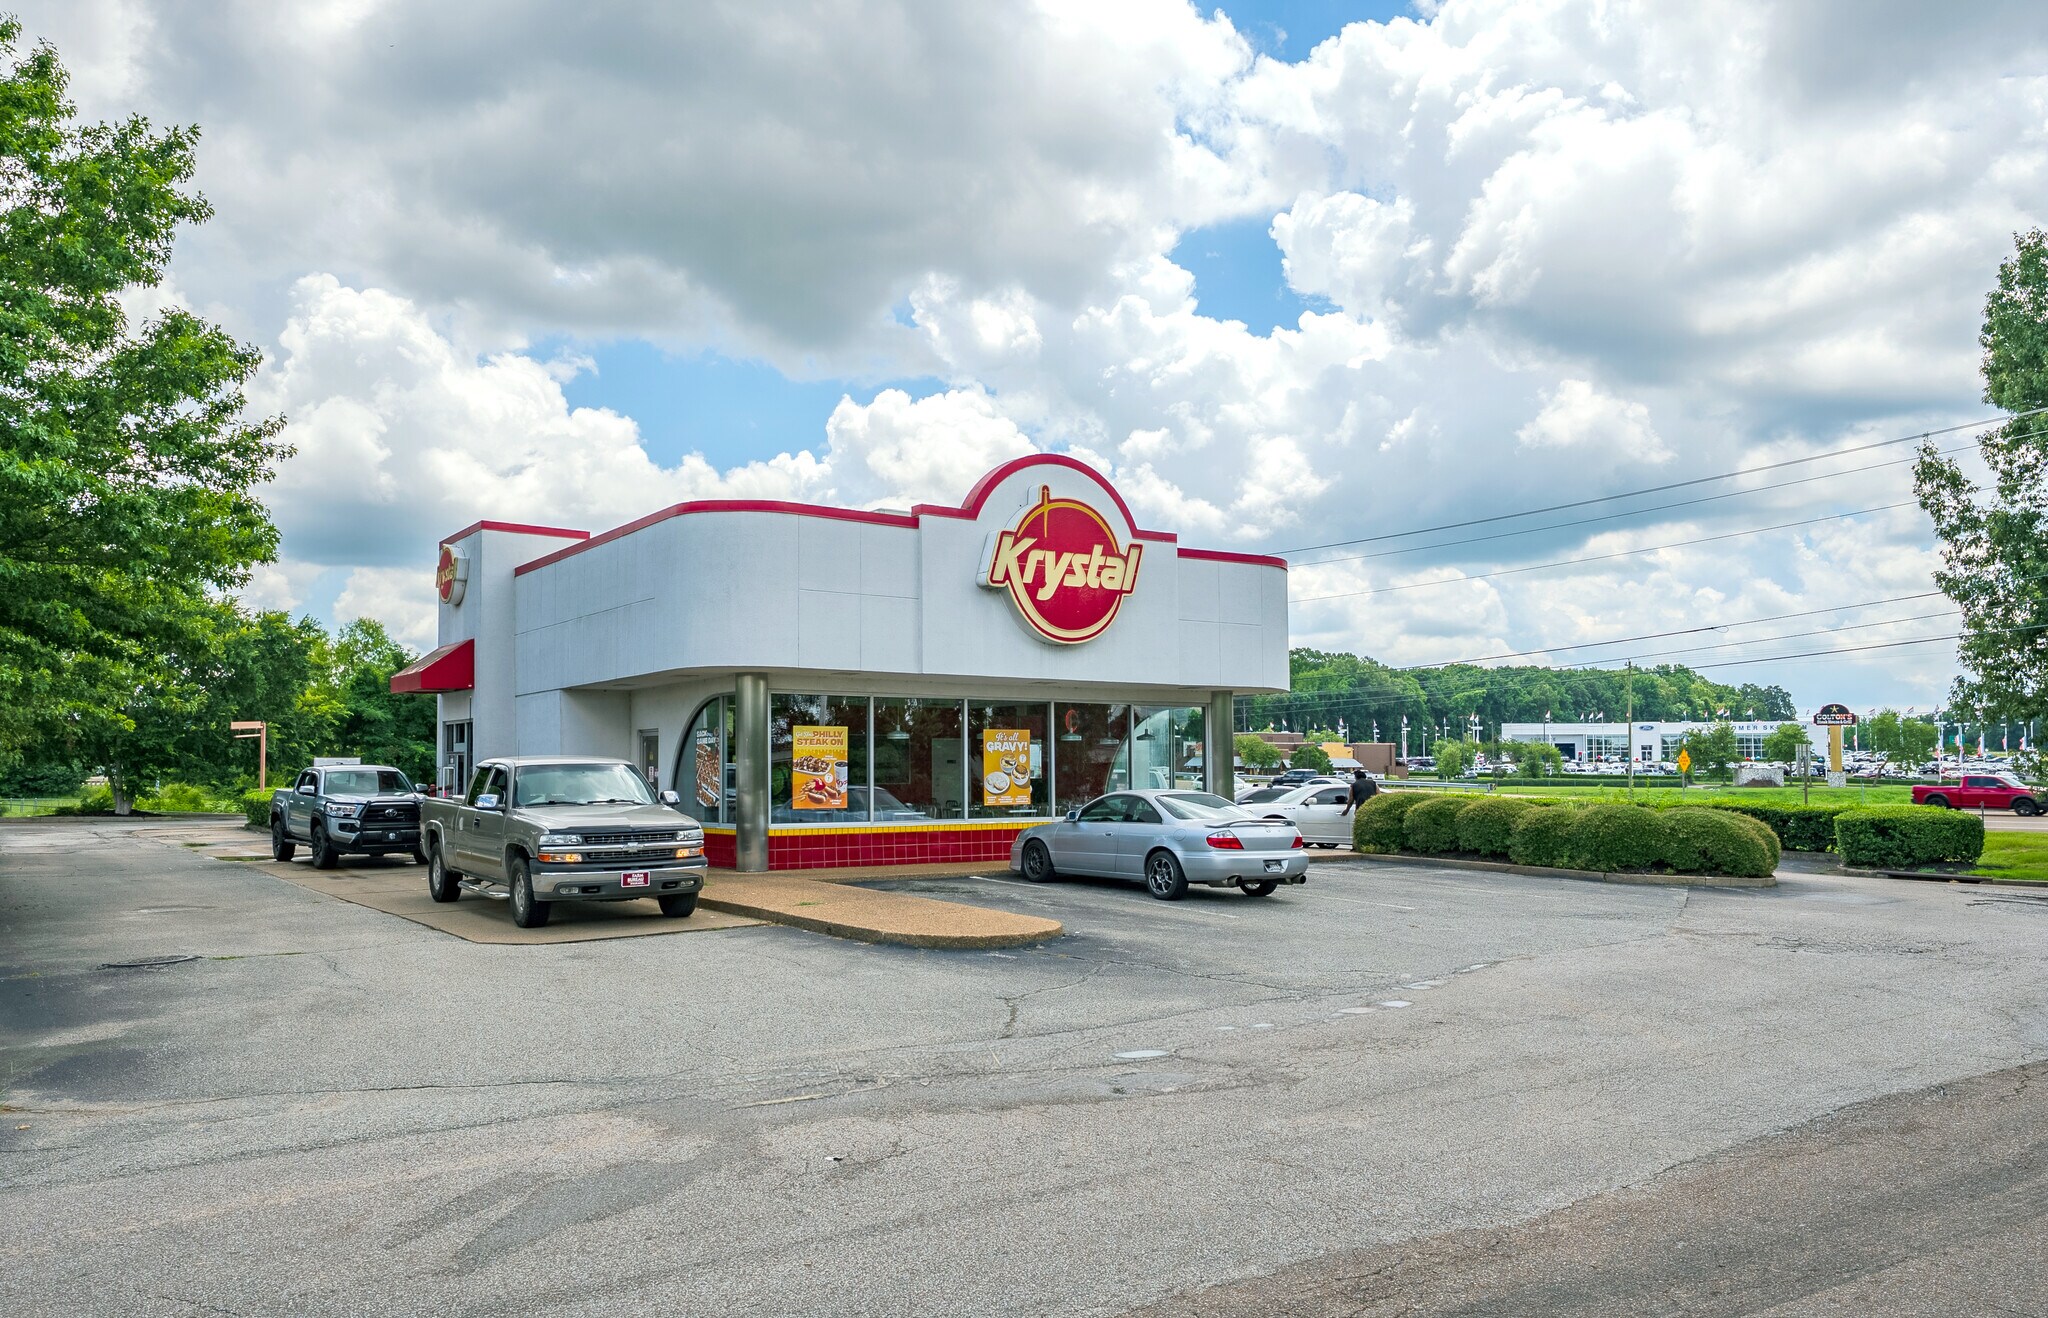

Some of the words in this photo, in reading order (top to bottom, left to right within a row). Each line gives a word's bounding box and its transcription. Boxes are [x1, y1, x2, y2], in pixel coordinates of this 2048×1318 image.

[993, 534, 1140, 601] Krystal
[996, 732, 1008, 741] It's
[1008, 732, 1019, 741] all
[796, 738, 829, 746] STEAK
[830, 738, 844, 746] ON
[986, 741, 1028, 753] GRAVY!
